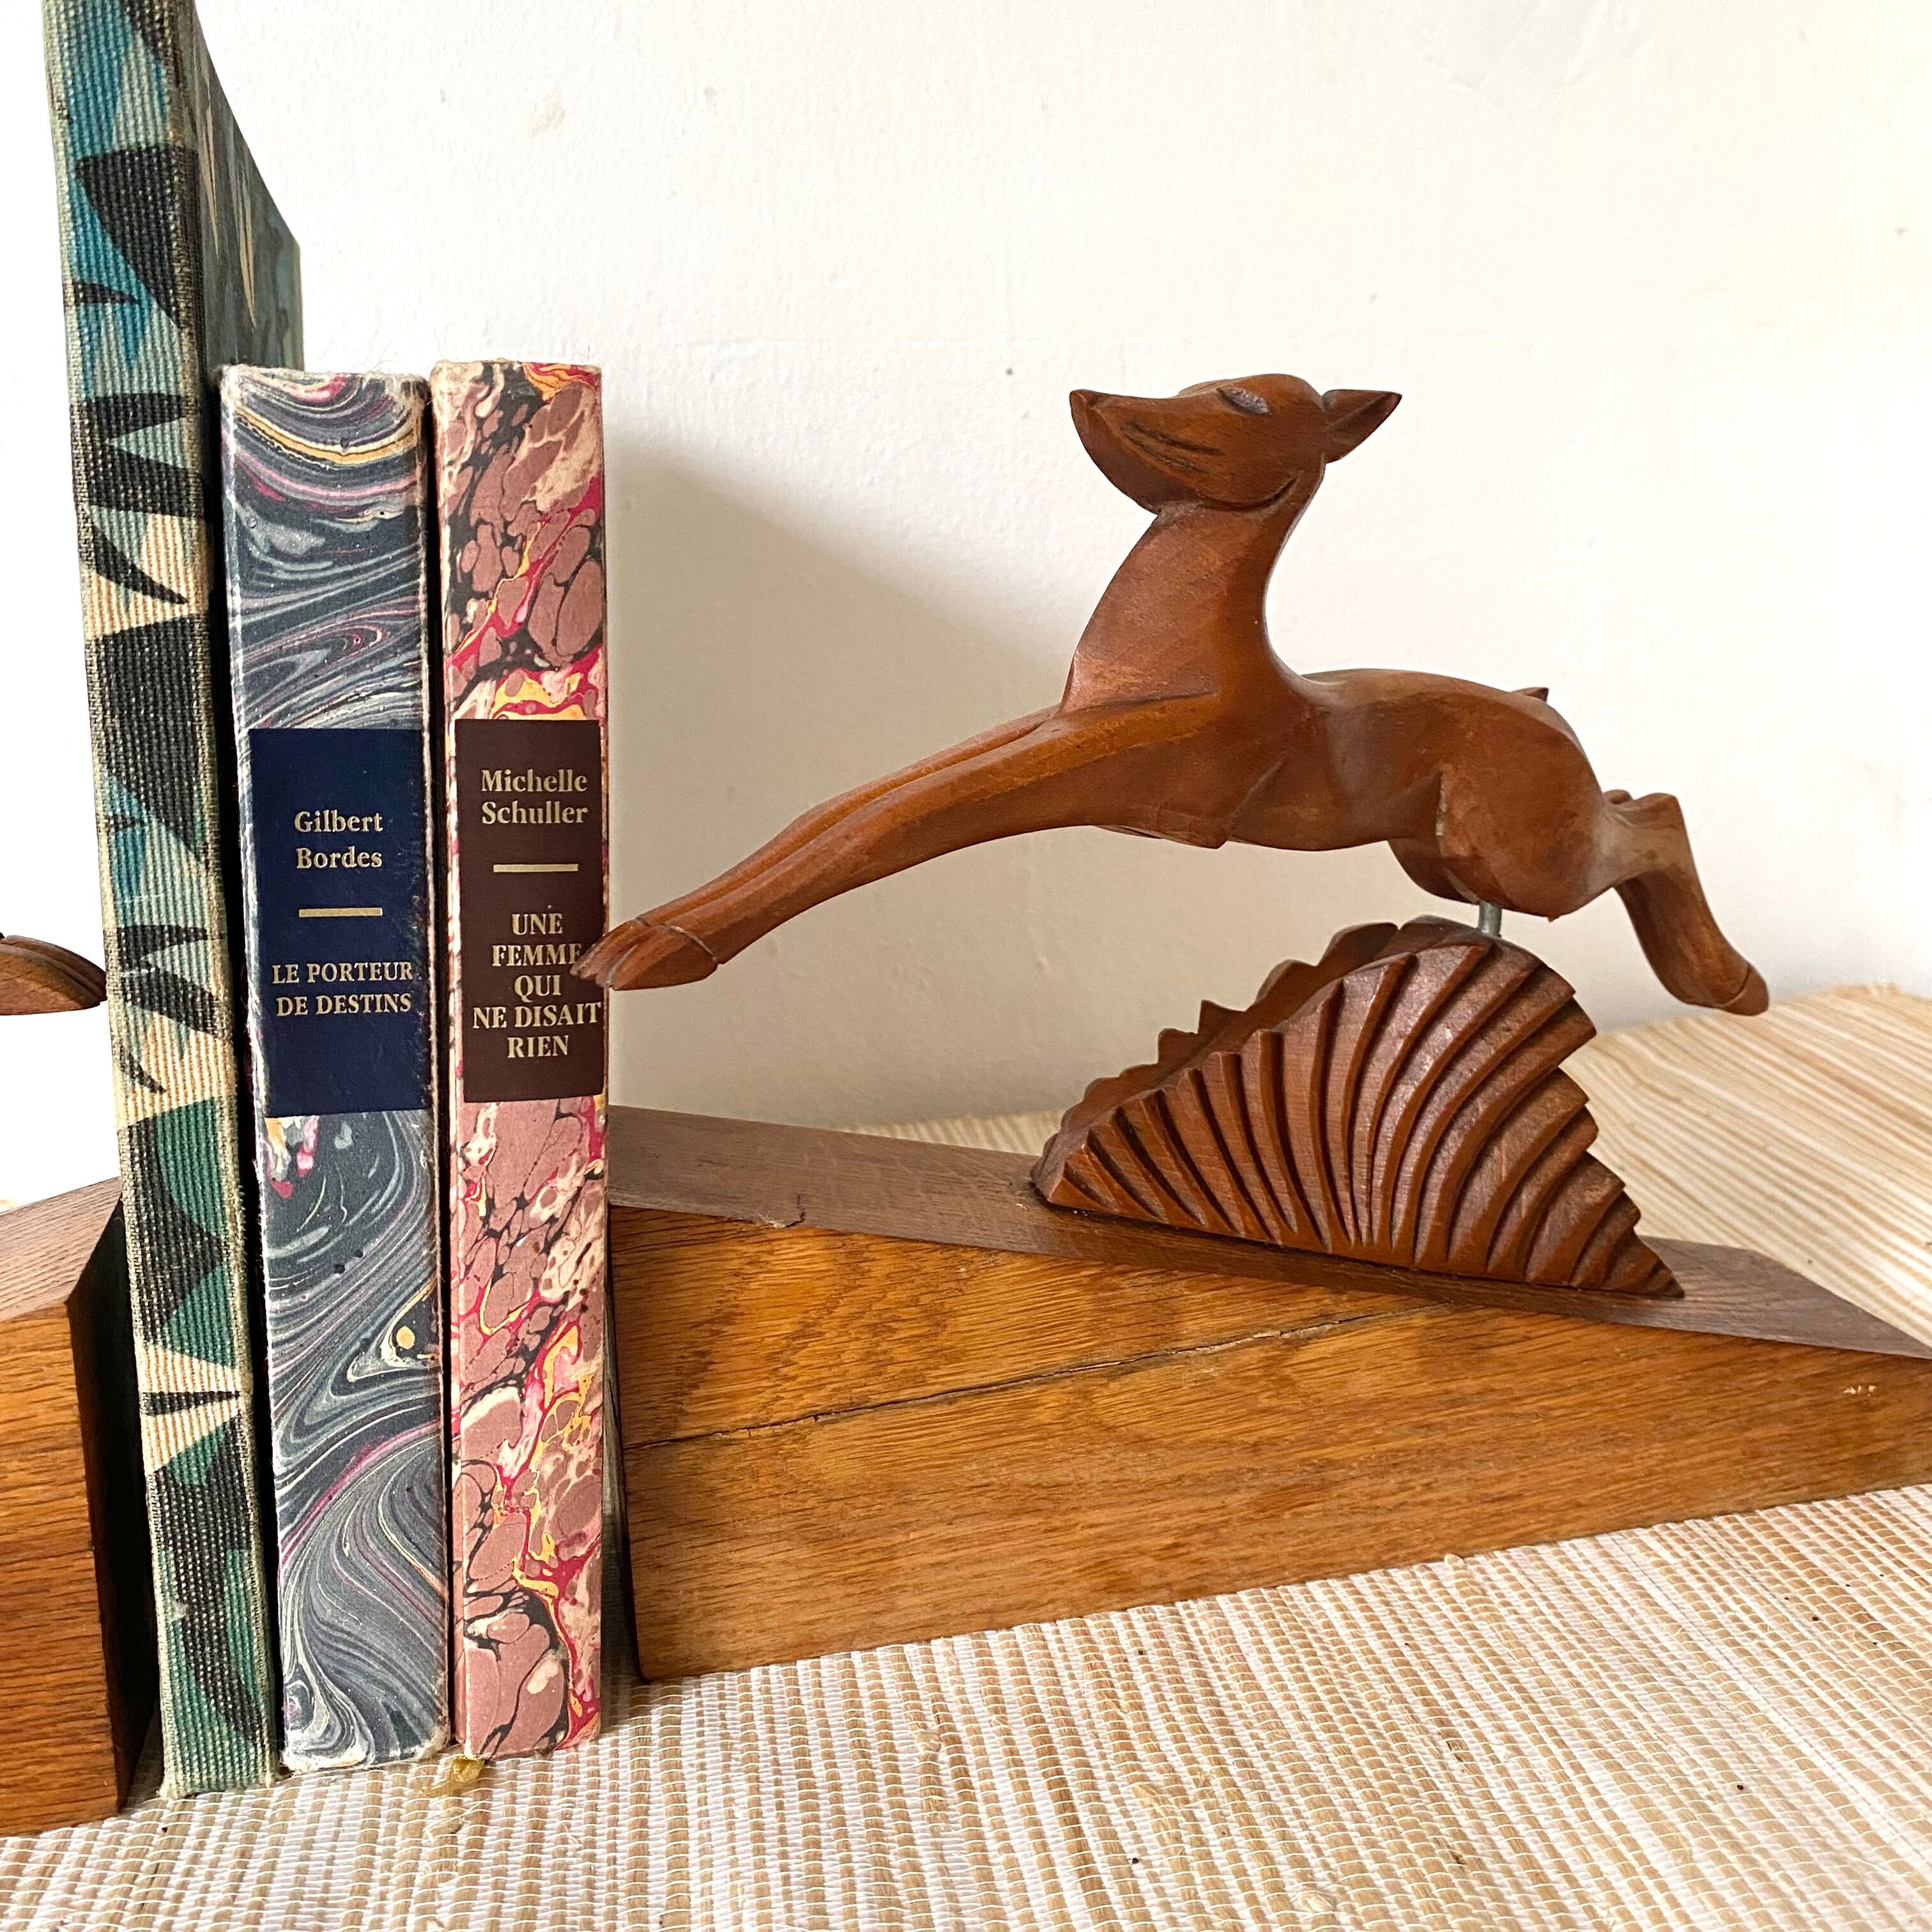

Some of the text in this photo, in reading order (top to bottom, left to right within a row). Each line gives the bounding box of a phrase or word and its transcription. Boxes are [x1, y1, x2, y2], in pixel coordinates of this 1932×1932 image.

[482, 769, 586, 792] Michelle
[295, 809, 383, 832] Gilbert
[482, 801, 588, 824] Schuller
[296, 846, 382, 868] Bordes
[512, 914, 562, 935] UNE
[493, 944, 582, 965] FEMME
[272, 962, 413, 983] LE PORTEUR
[515, 975, 561, 1002] QUI
[277, 993, 411, 1016] DE DESTINS
[473, 1001, 601, 1029] NE DISAIT
[507, 1035, 569, 1058] RIEN
